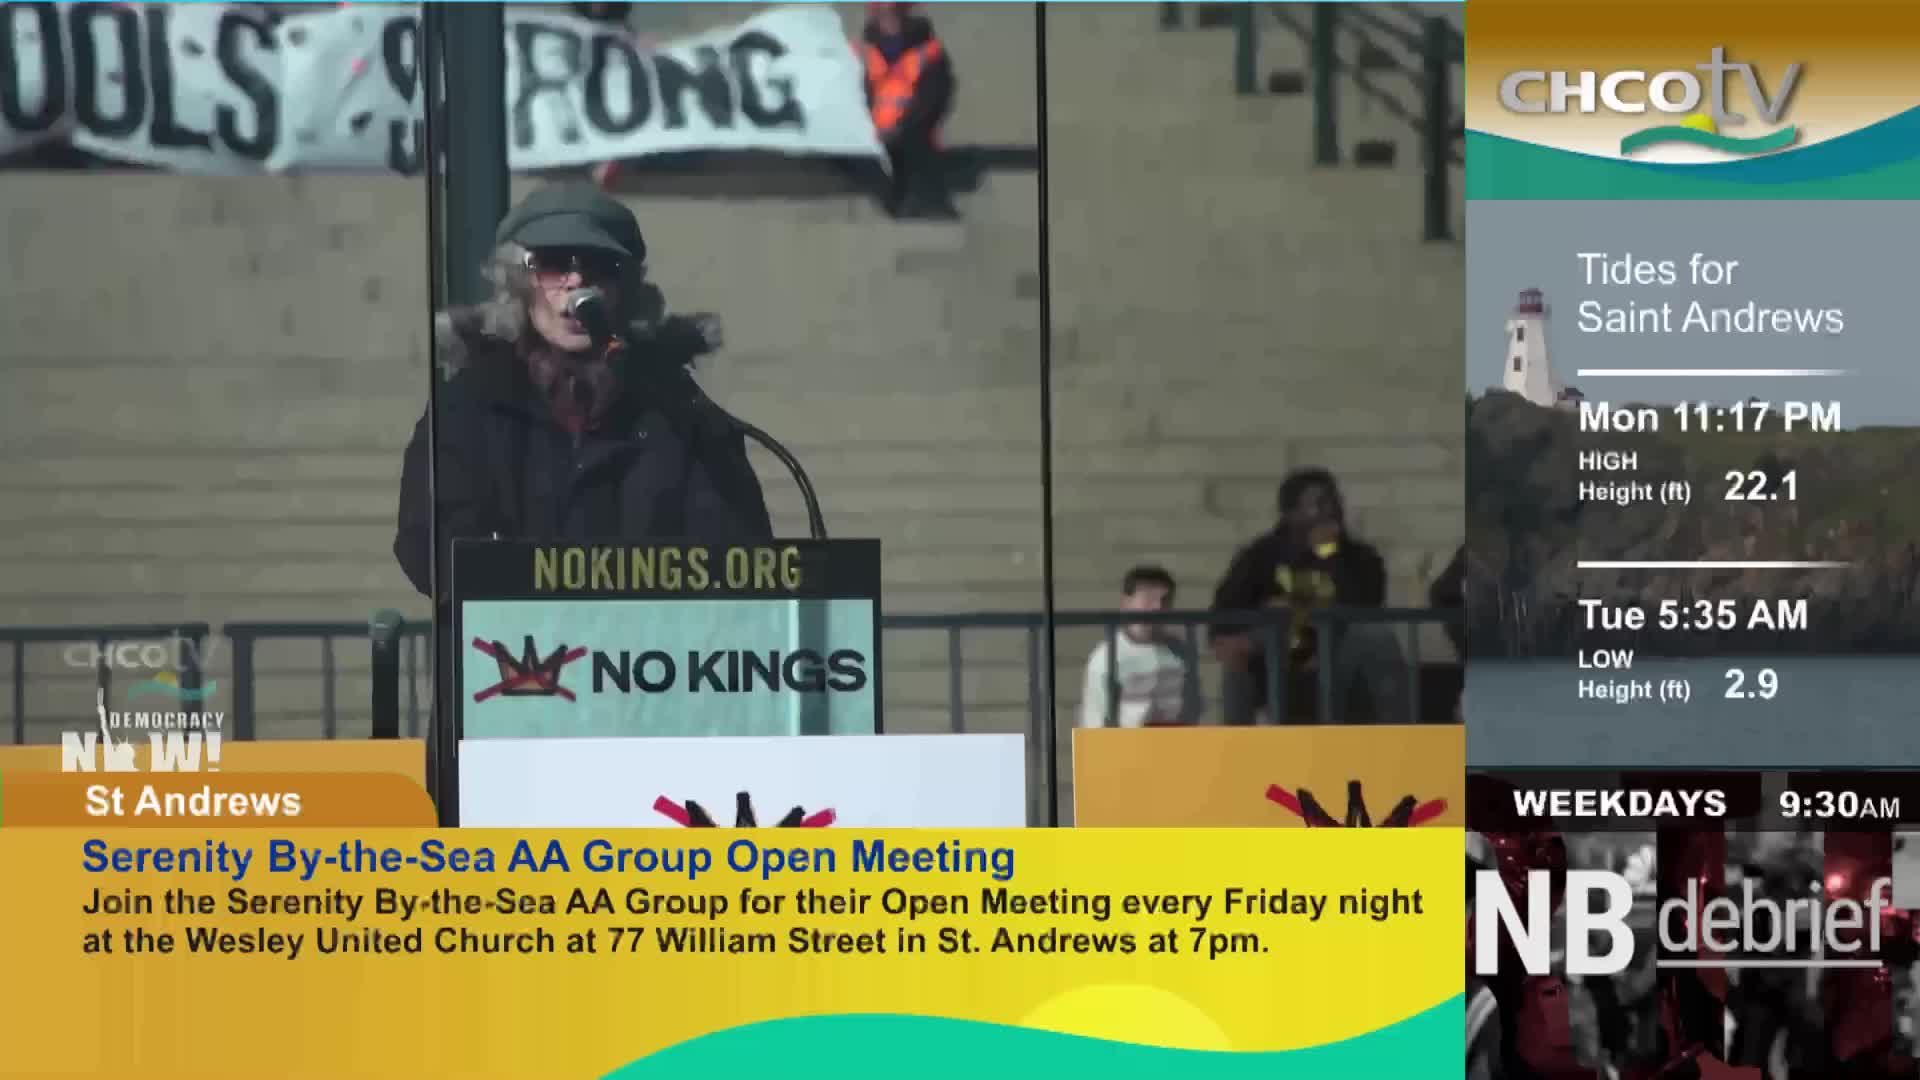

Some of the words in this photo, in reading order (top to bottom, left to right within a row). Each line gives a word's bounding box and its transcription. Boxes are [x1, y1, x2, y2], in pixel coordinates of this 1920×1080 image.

[534, 546, 801, 591] NOKINGS.ORG
[592, 650, 677, 693] NO
[687, 648, 868, 693] KINGS
